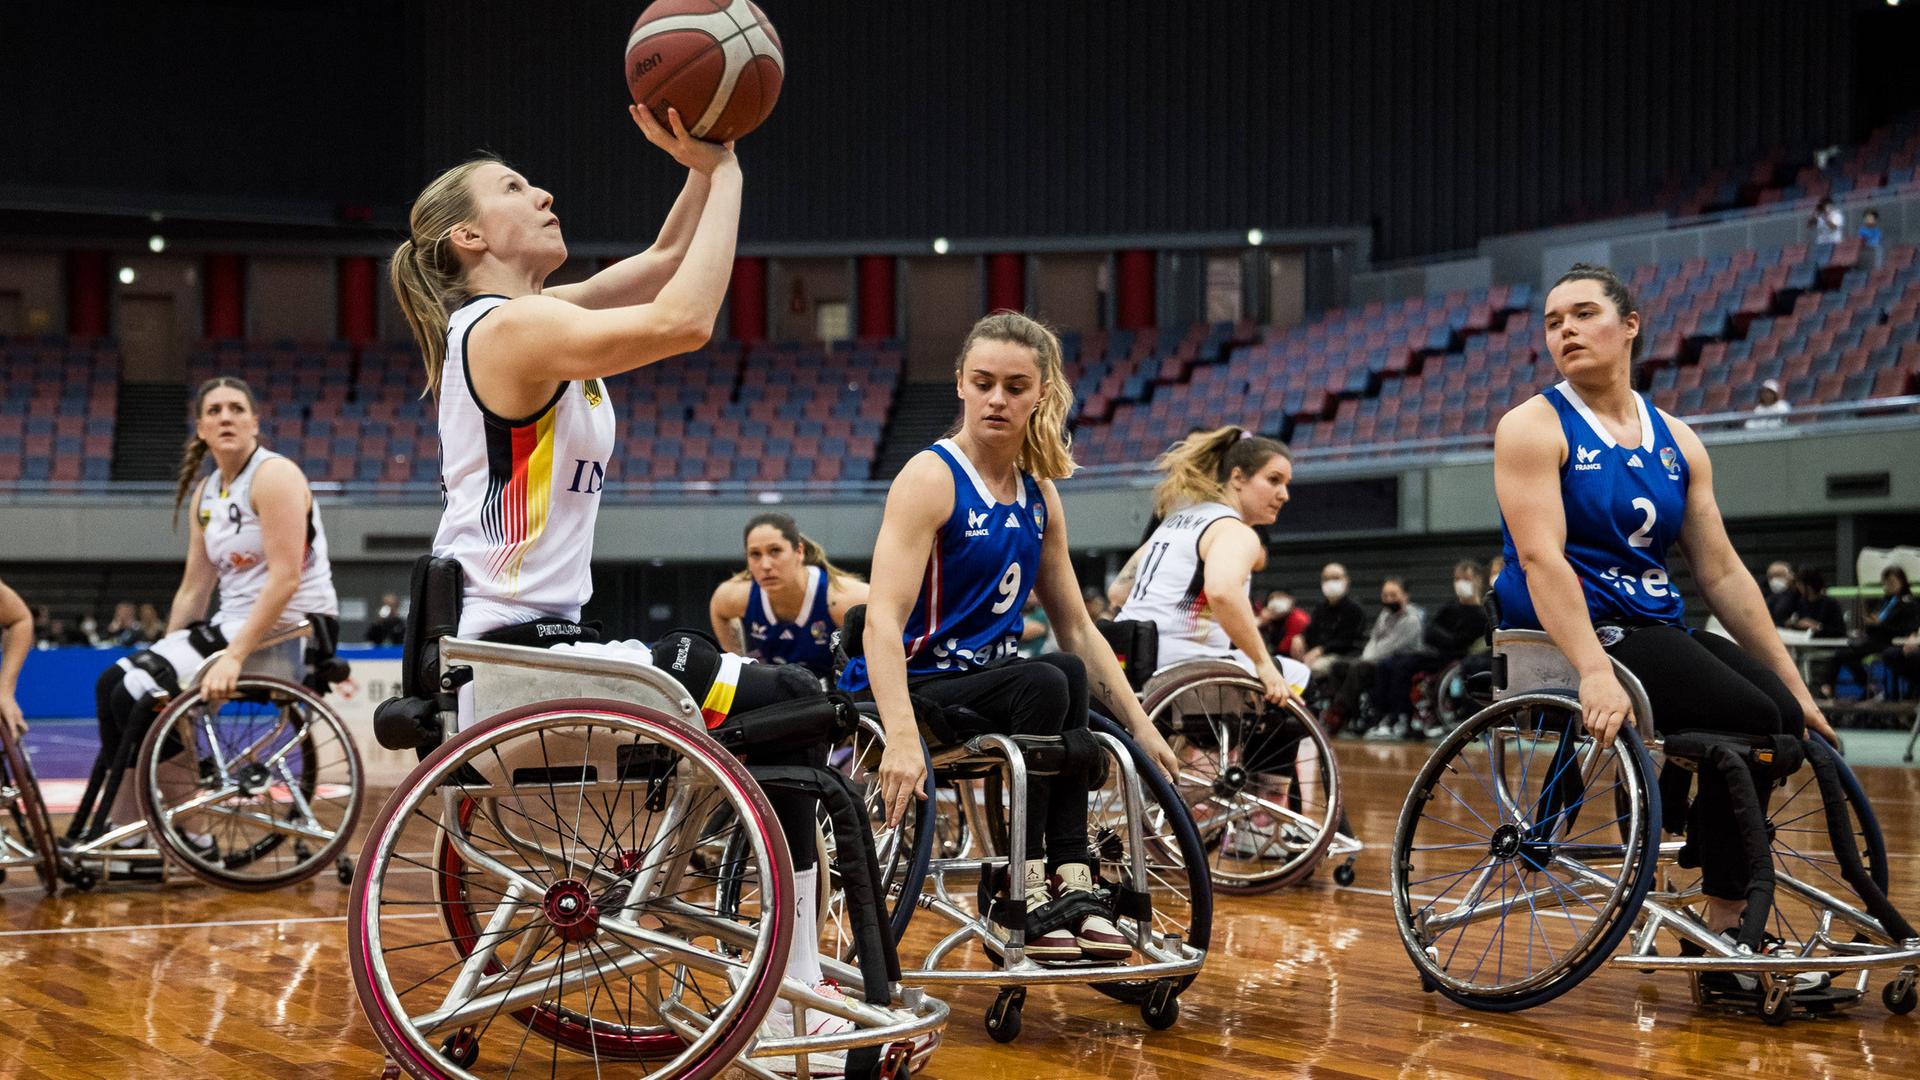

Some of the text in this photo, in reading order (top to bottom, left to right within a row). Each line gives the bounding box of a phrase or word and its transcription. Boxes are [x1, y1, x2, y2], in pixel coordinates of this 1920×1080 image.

[1575, 463, 1601, 471] FRANCE
[229, 503, 242, 534] 9
[965, 528, 989, 538] FRANCE
[1628, 496, 1657, 548] 2
[991, 561, 1022, 615] 9
[1133, 541, 1170, 601] 11
